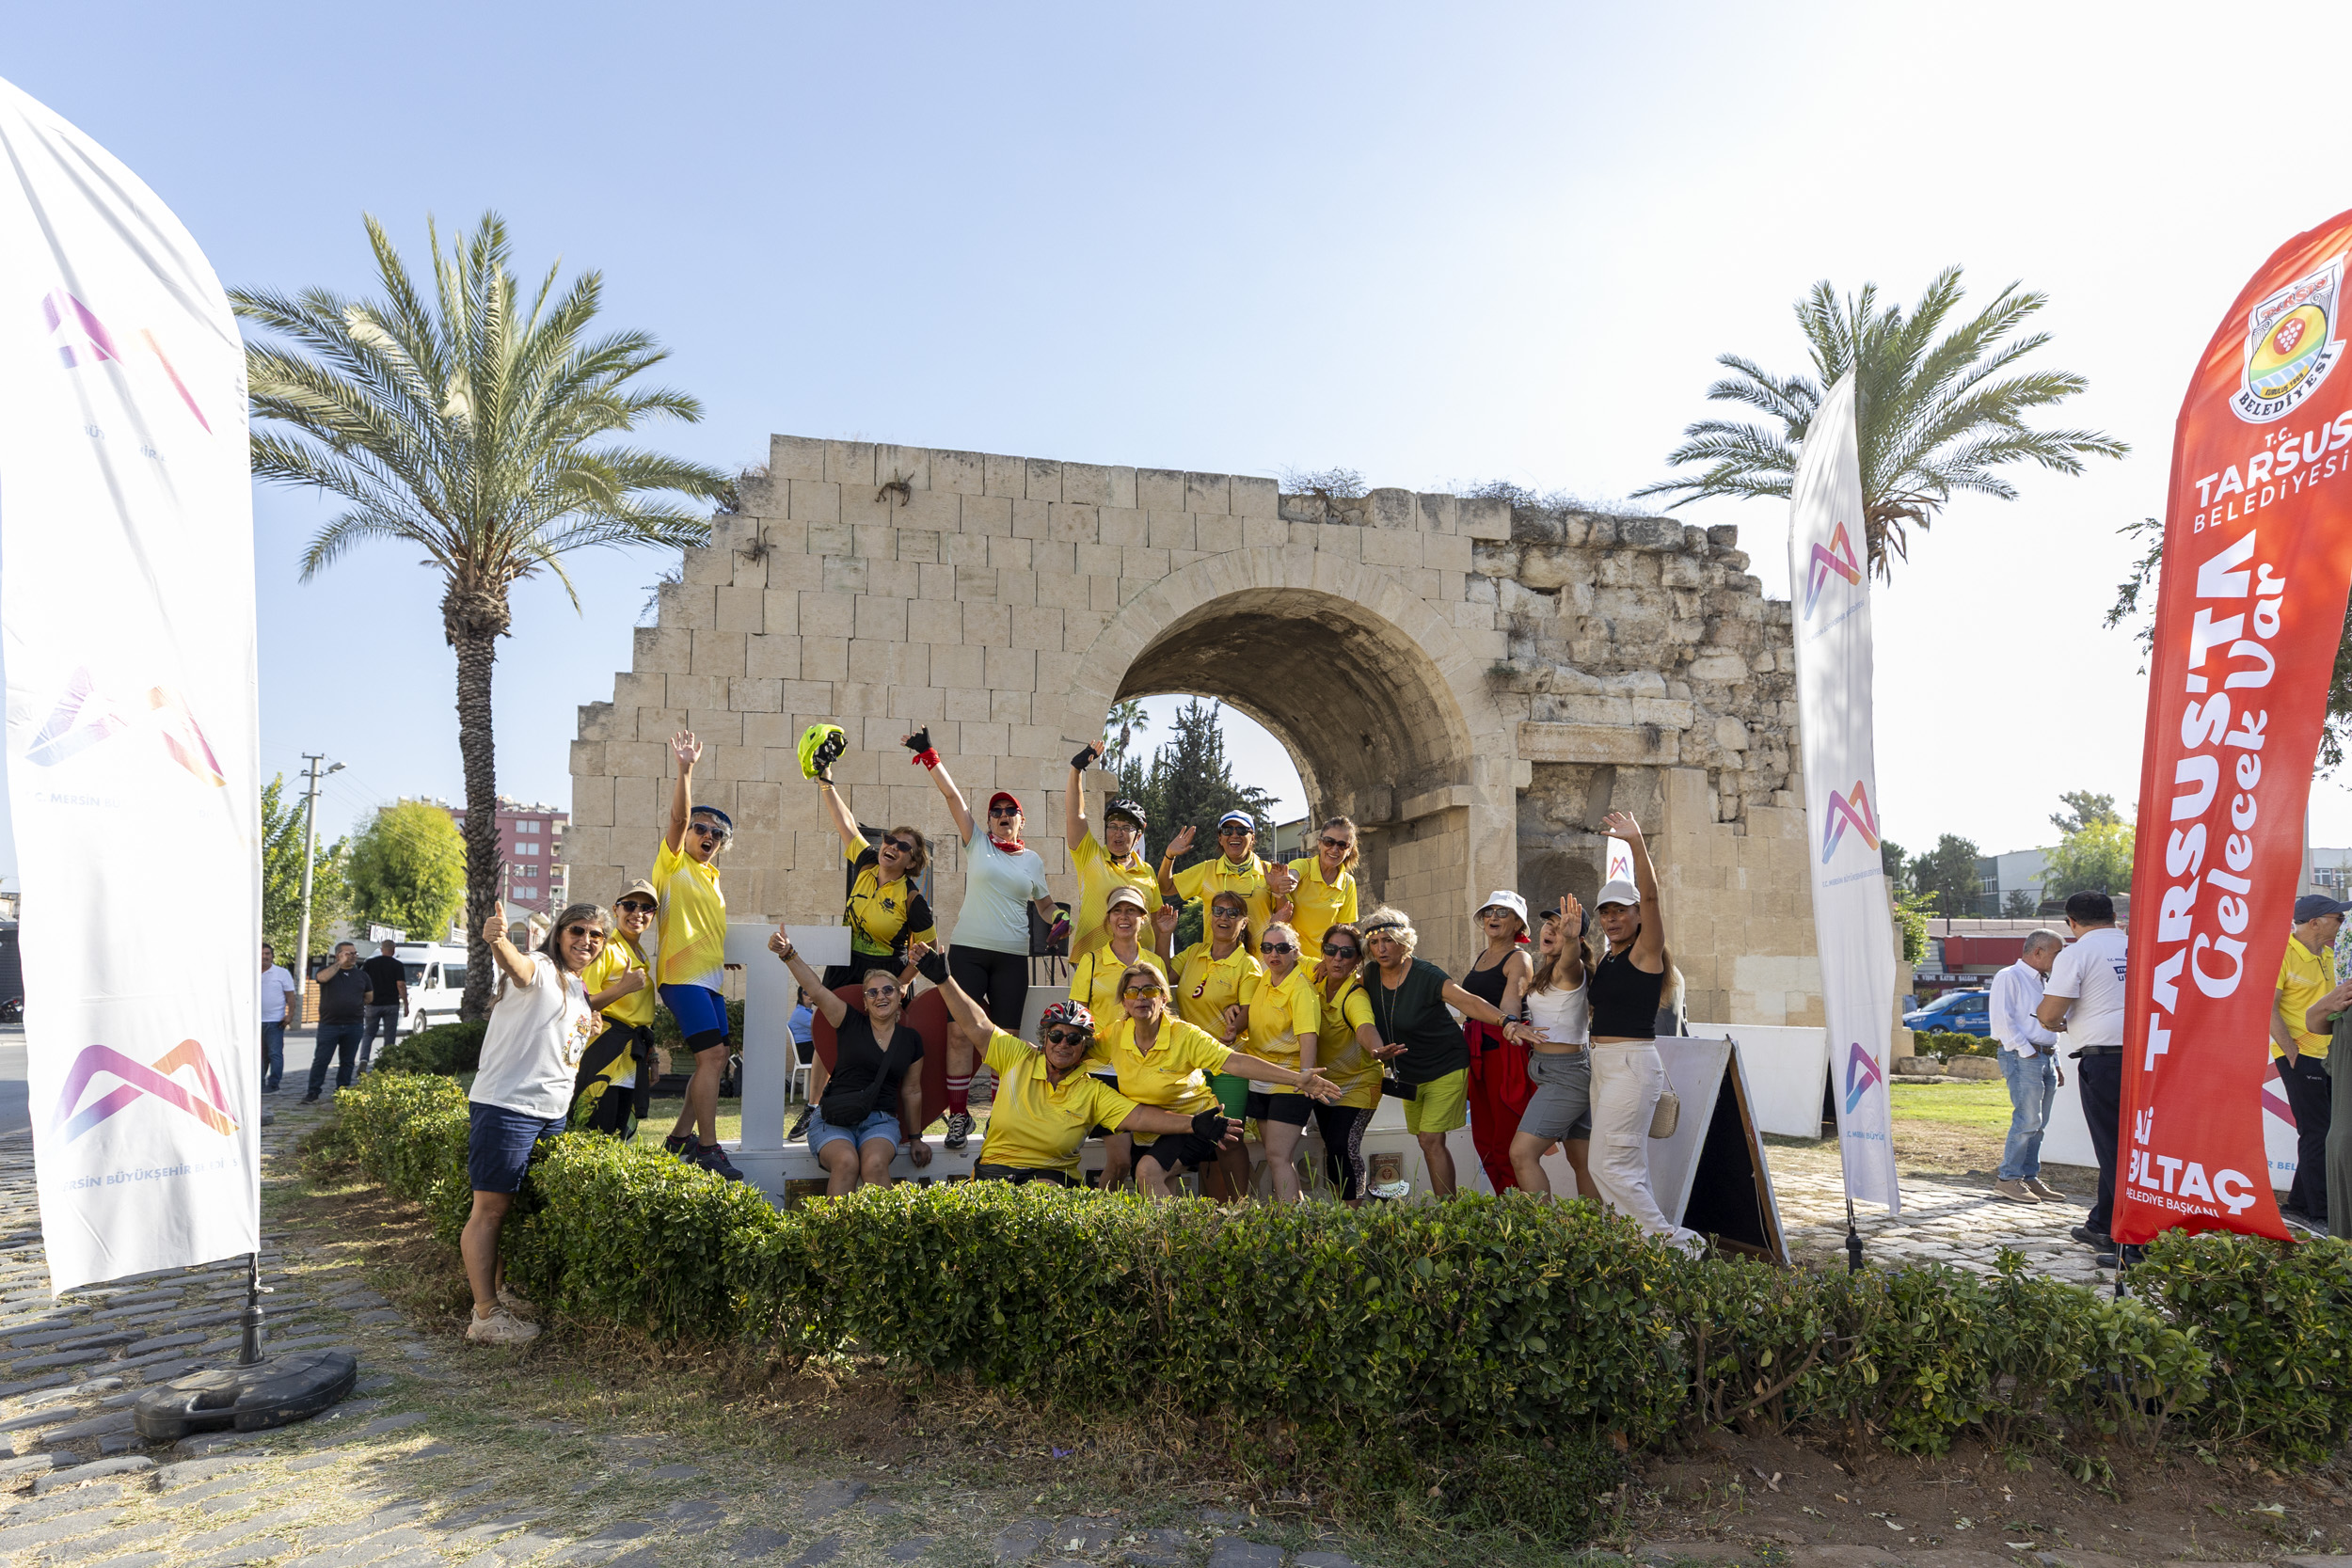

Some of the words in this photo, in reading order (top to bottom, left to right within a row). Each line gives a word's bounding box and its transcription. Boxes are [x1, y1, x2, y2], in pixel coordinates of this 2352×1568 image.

[2238, 352, 2333, 417] BELEDİYESİ
[2195, 410, 2352, 509] TARSUS
[2265, 427, 2293, 448] T.C.
[2194, 449, 2349, 534] BELEDİYESİ
[2224, 562, 2286, 689] Var
[50, 791, 101, 807] MERSİN
[2191, 709, 2268, 999] Gelecek
[61, 1174, 103, 1193] ERSİN
[106, 1163, 192, 1186] BÜYÜKŞEHİR
